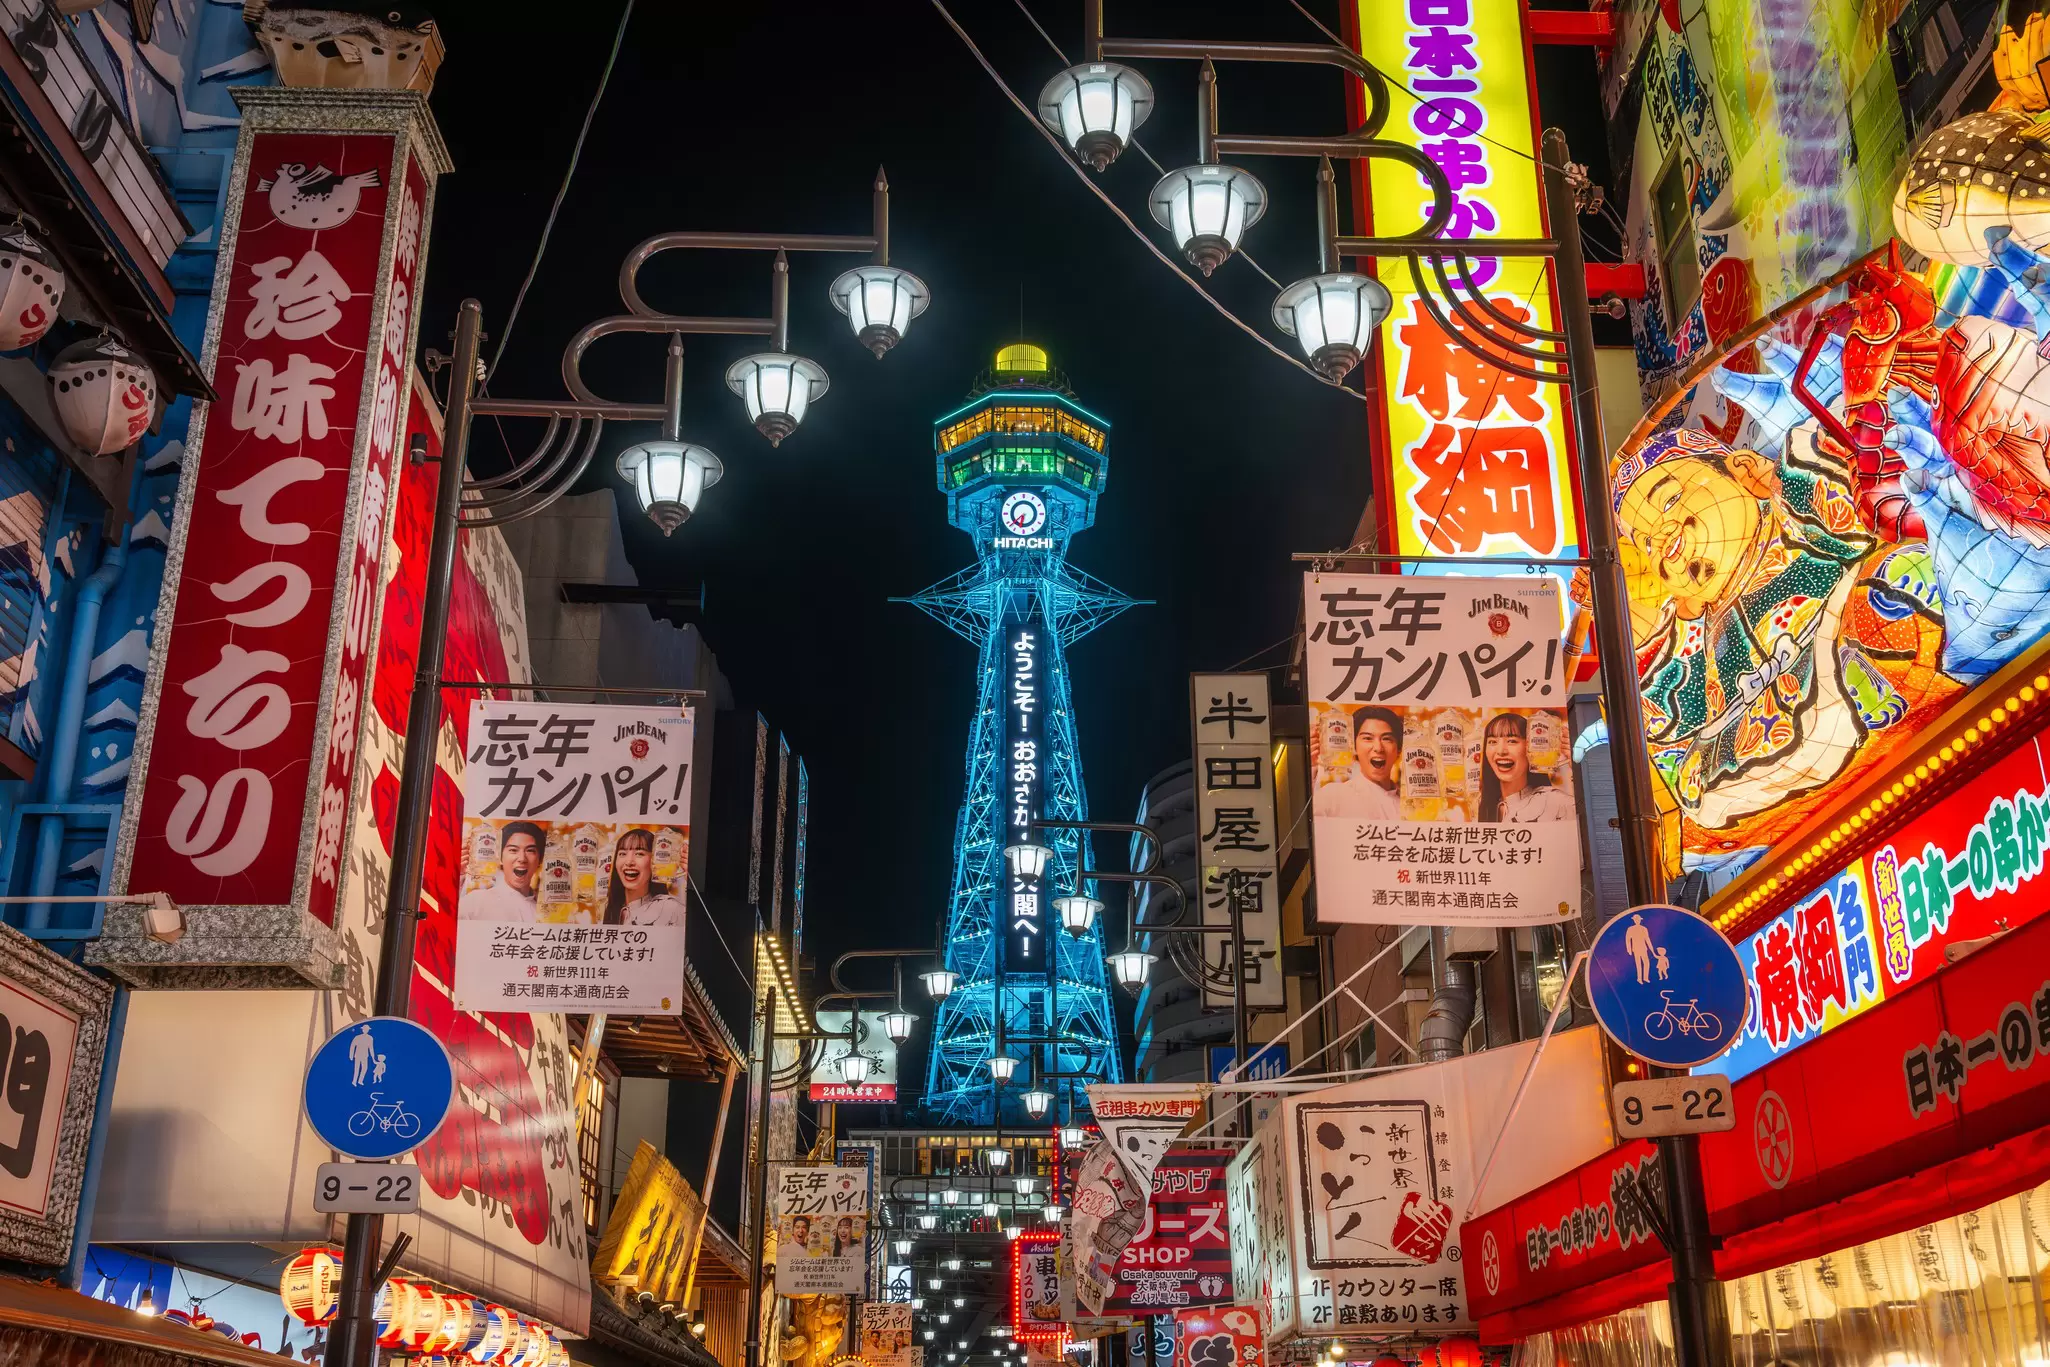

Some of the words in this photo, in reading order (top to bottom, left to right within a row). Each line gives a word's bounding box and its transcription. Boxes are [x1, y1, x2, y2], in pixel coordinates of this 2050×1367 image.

[1401, 297, 1558, 556] 横綱
[994, 537, 1053, 549] HITACHI
[1309, 587, 1446, 646] 忘年
[1468, 598, 1492, 619] JIM
[1493, 593, 1530, 619] BEAM
[1326, 639, 1558, 702] カンパイッ!
[470, 714, 595, 767] 忘年
[613, 724, 635, 743] JIM
[636, 721, 668, 745] BEAM
[480, 763, 688, 817] カンパイッ!
[1408, 776, 1437, 784] BOURBON
[1201, 691, 1275, 985] 半田屋酒店
[1356, 824, 1532, 845] ジムビームは新世界での
[1353, 844, 1542, 865] 忘年会を応援しています!
[1397, 869, 1411, 884] 祝
[1415, 870, 1492, 886] 新世界111年
[1901, 795, 2050, 942] 日本一の串か
[1372, 889, 1519, 909] 通天閣南本通商店会
[1875, 850, 1909, 977] 新世界
[493, 926, 648, 944] ジムビームは新世界での
[489, 943, 654, 962] 忘年会を応援しています!
[526, 965, 539, 978] 祝
[543, 966, 609, 980] 新世界111年
[1755, 894, 1846, 1048] 横綱
[1837, 881, 1874, 1003] 名門
[502, 982, 630, 1000] 通天閣南本通商店会
[780, 1172, 829, 1194] 忘年
[1527, 1203, 1610, 1270] 日本一の串かつ
[1030, 1242, 1054, 1253] Asahi
[1123, 1248, 1190, 1264] SHOP
[1035, 1255, 1059, 1305] 串カツ
[1121, 1270, 1153, 1280] Osaka
[1154, 1270, 1197, 1280] souvenir
[1138, 1281, 1181, 1293] 大阪特产
[1313, 1280, 1331, 1297] 1F
[1338, 1278, 1457, 1297] カウンター席
[864, 1306, 890, 1318] 忘年
[1313, 1307, 1333, 1324] 2F
[1339, 1306, 1460, 1325] 座敷あります
